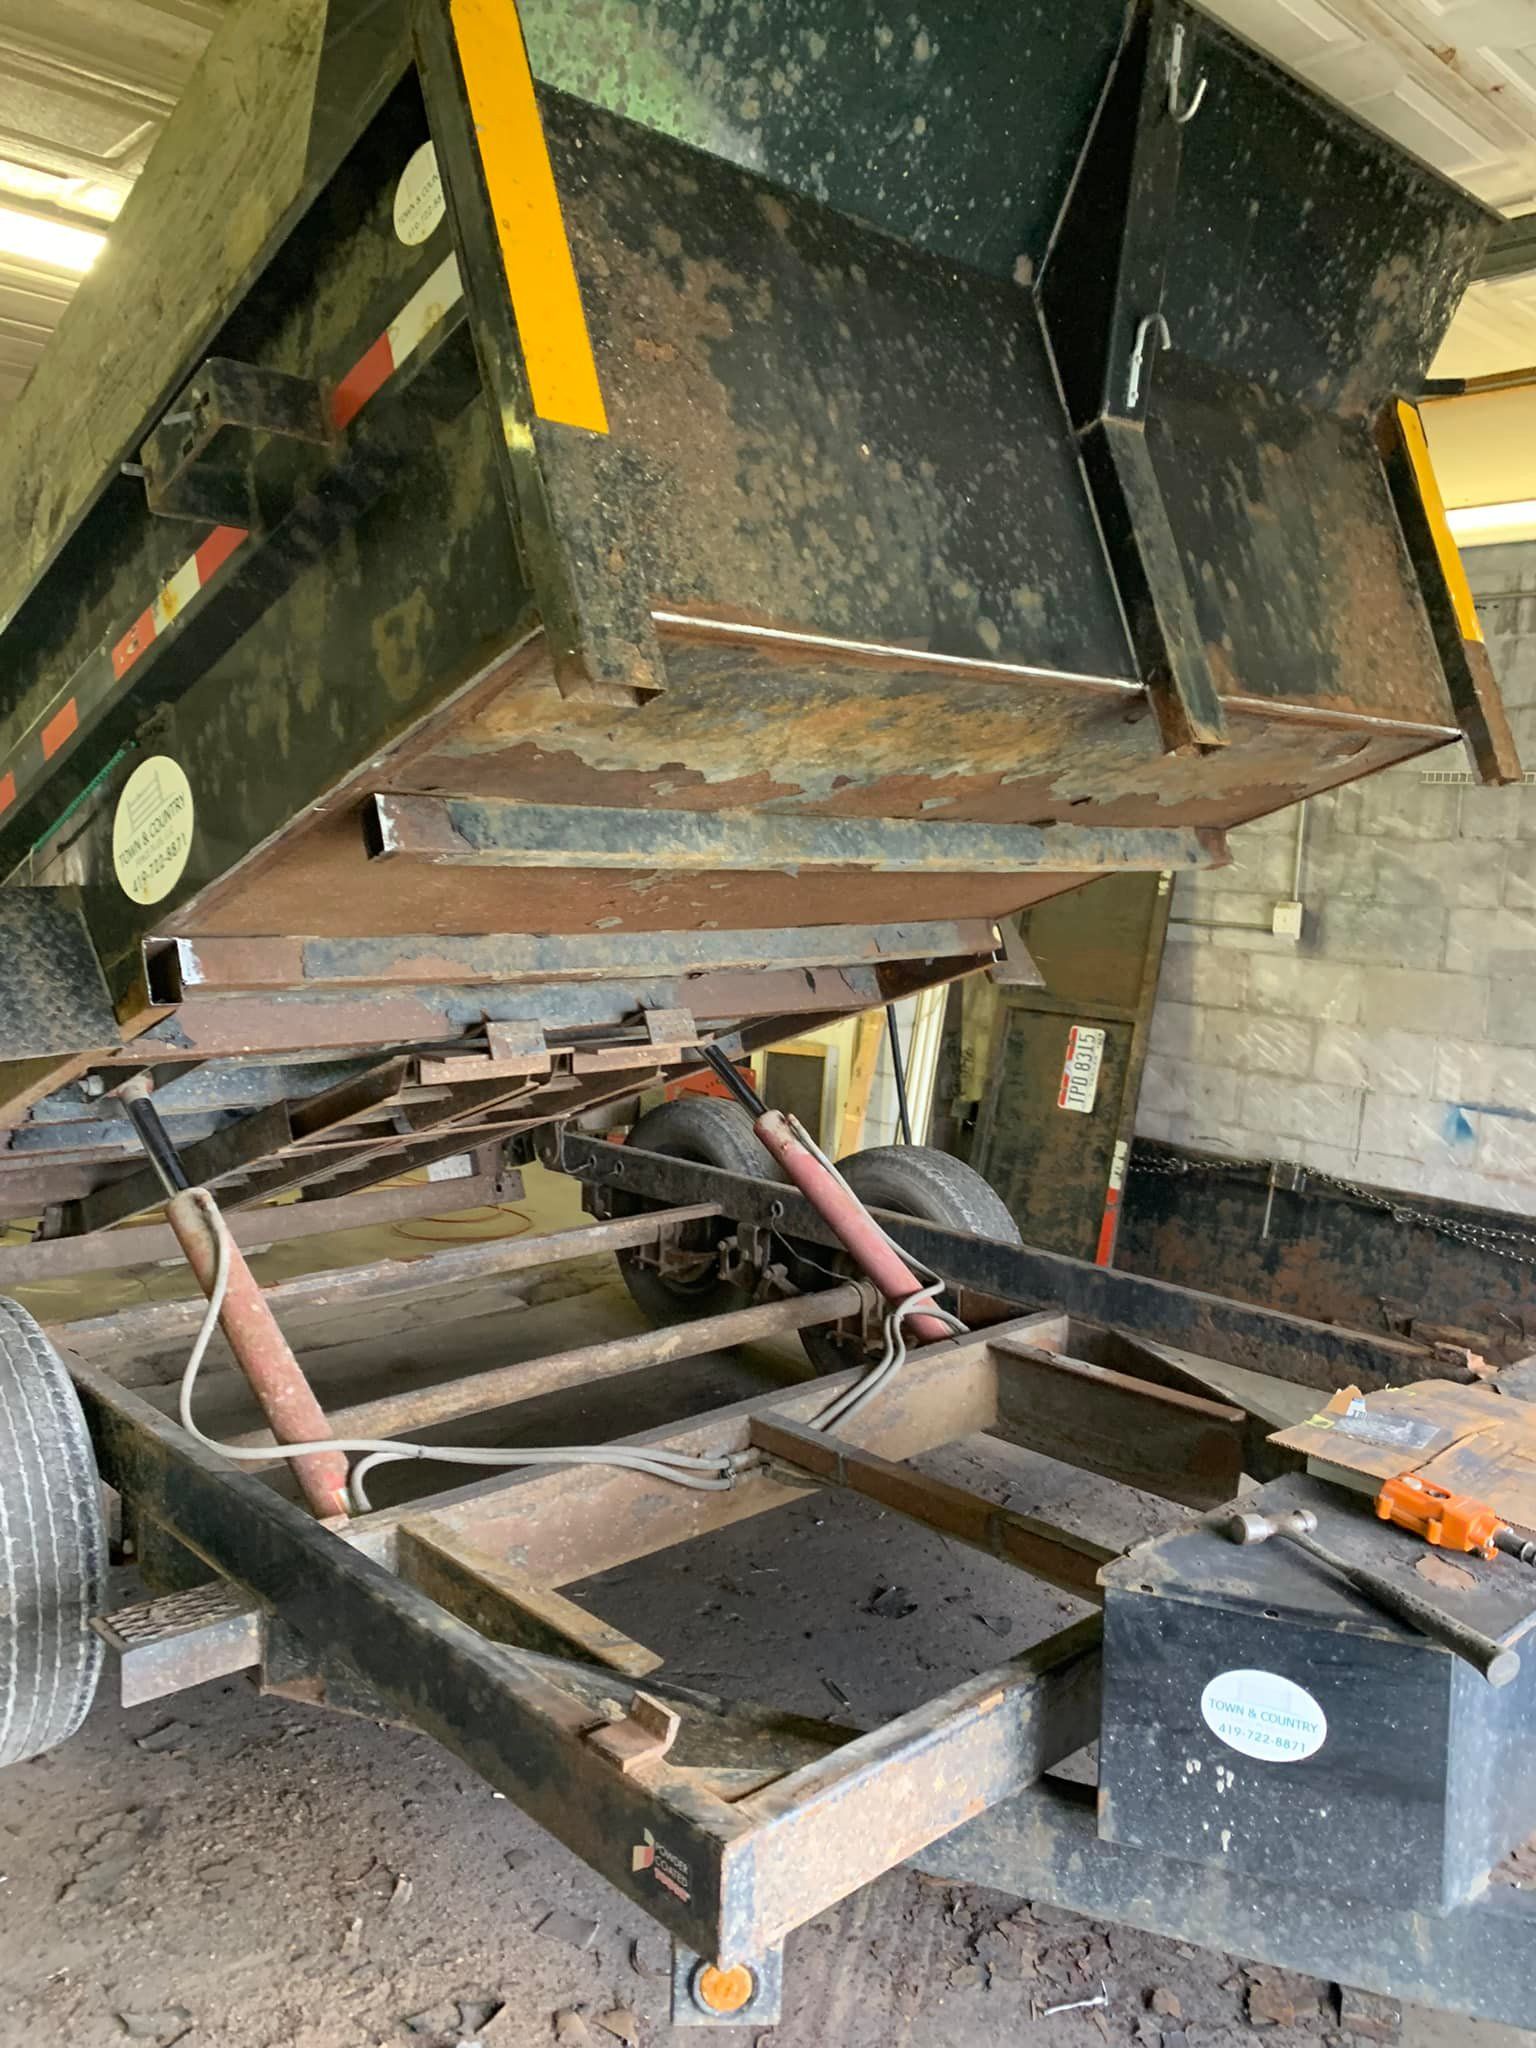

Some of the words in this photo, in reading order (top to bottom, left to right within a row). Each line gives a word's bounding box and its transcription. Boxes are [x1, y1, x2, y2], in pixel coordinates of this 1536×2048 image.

[118, 838, 142, 867] TOWN
[141, 831, 150, 847] &
[149, 792, 185, 839] COUNTRY
[132, 832, 188, 893] 419-722-8871
[1074, 1032, 1096, 1072] 8315
[1208, 1698, 1245, 1717] TOWN
[1248, 1708, 1257, 1720] &
[1260, 1710, 1320, 1735] COUNTRY
[1218, 1722, 1307, 1753] 419-722-8871
[654, 1855, 689, 1888] COATED
